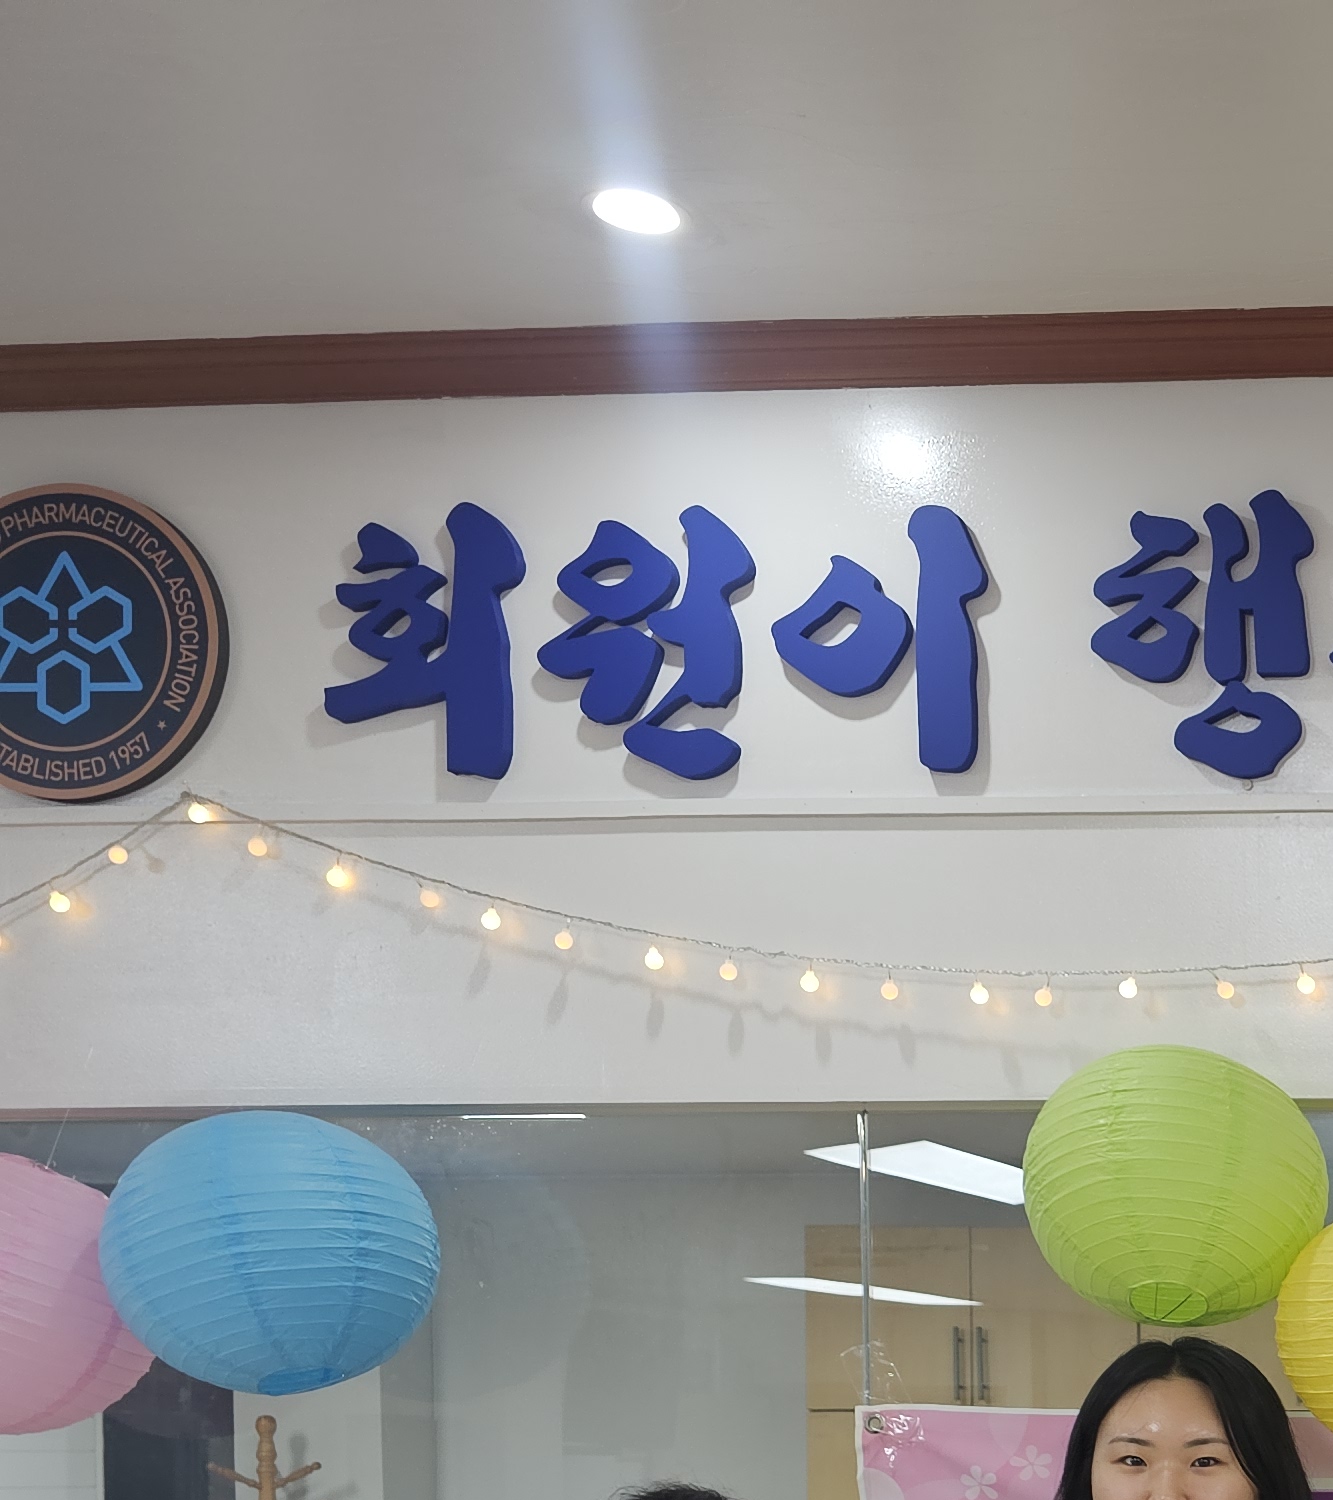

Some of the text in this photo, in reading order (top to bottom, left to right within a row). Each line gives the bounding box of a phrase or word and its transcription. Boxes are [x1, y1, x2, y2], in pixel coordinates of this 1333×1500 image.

[1, 502, 200, 713] PHARMACEUTICAL ASSOCIATION
[324, 502, 989, 780] 회원이
[0, 731, 152, 782] TABLISHED 1957
